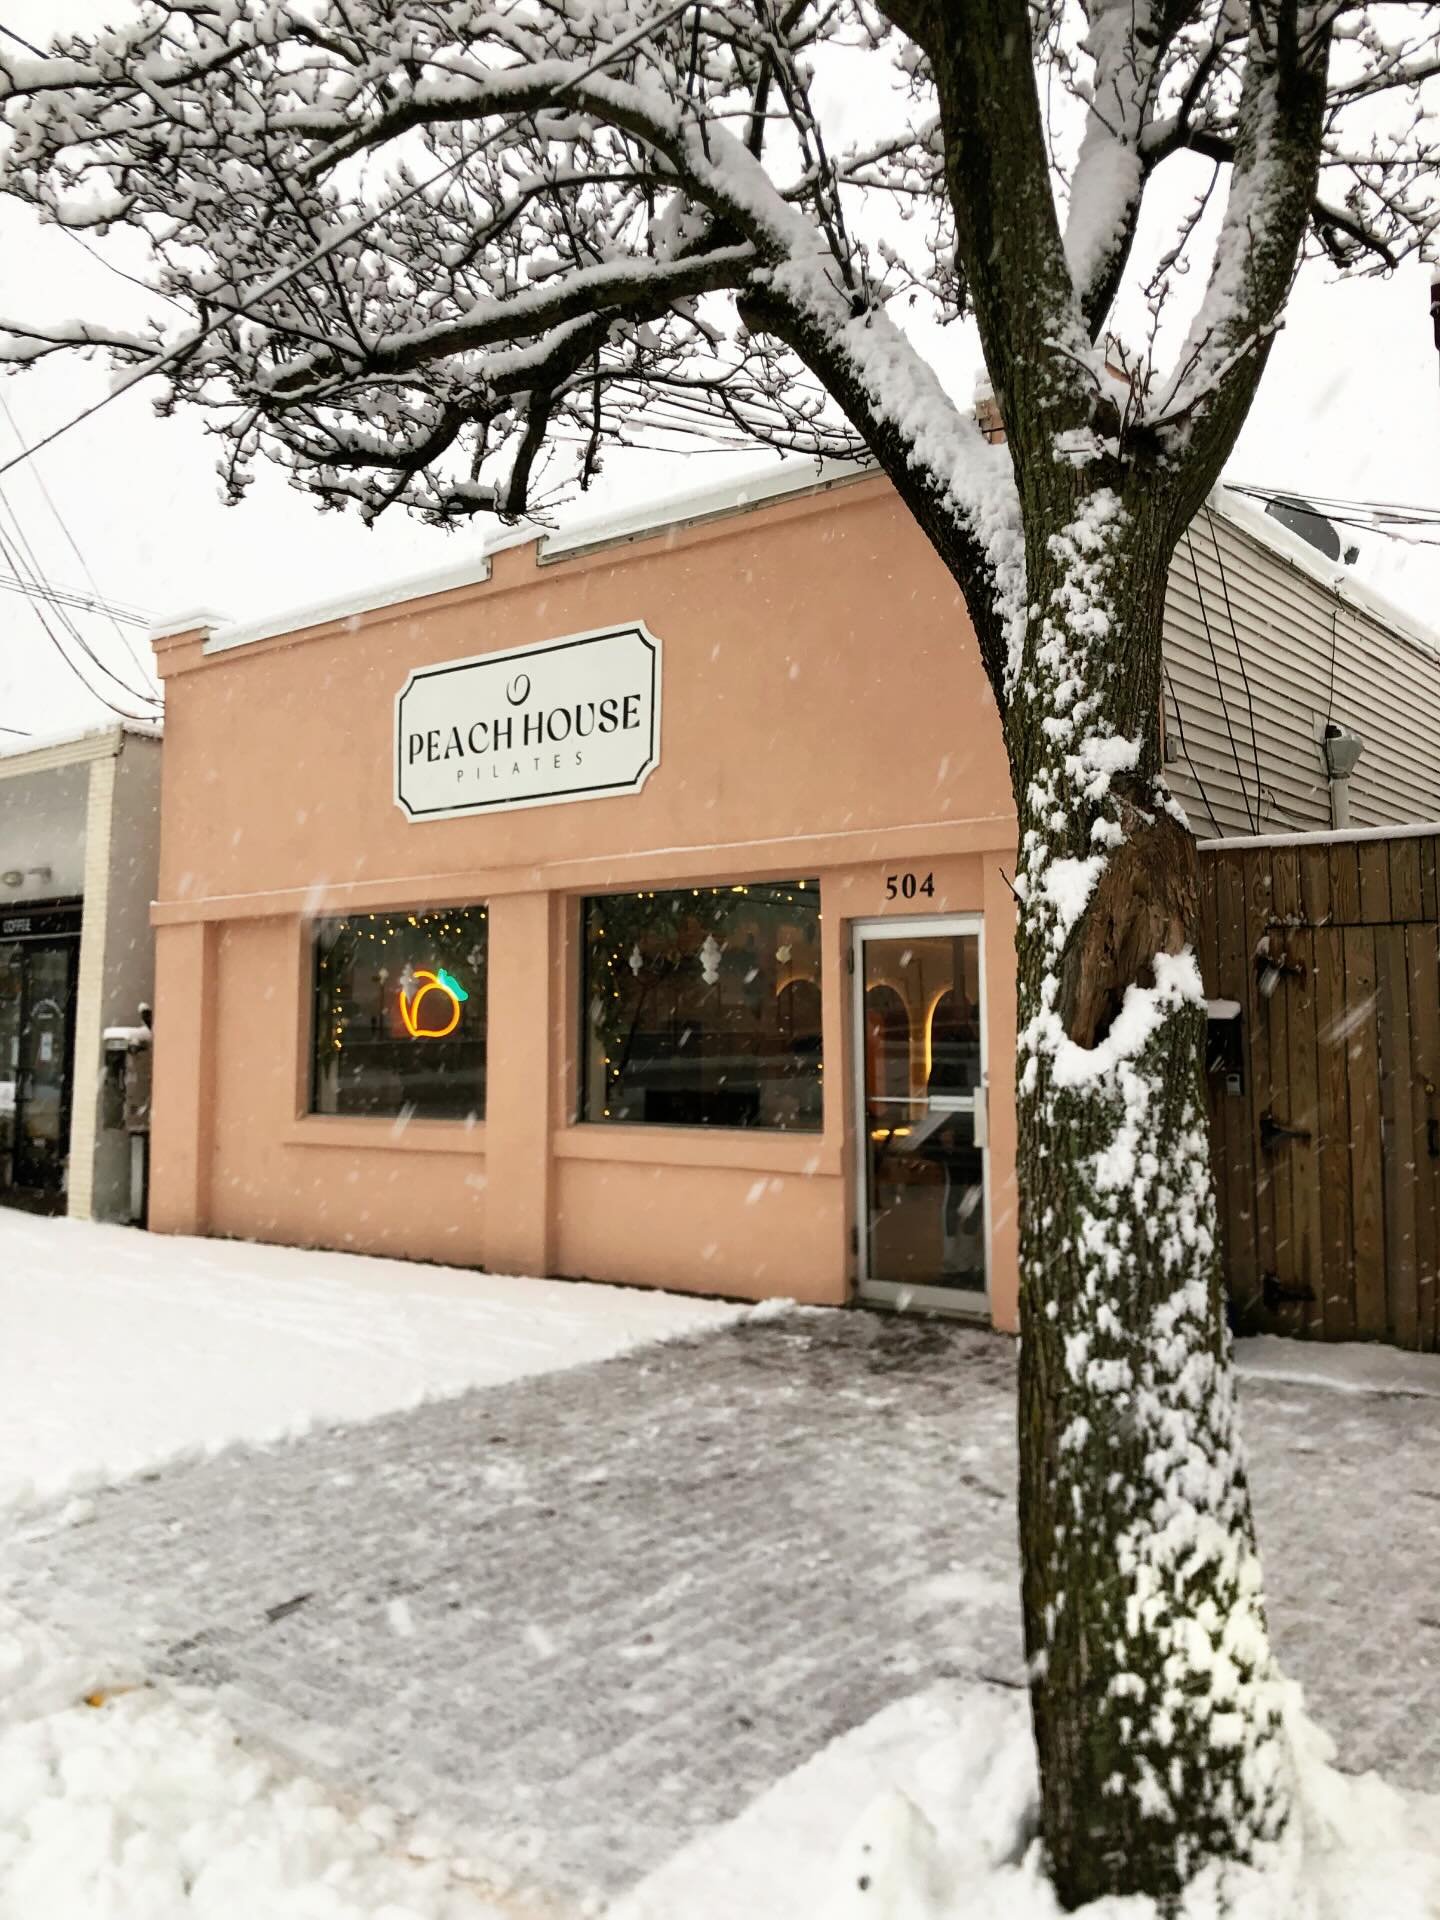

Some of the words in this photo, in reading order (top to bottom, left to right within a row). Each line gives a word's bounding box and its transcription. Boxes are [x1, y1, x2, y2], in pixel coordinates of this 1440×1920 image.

[408, 717, 513, 765] PEACH
[523, 694, 641, 746] HOUSE
[457, 751, 583, 782] PILATES
[885, 872, 935, 900] 504
